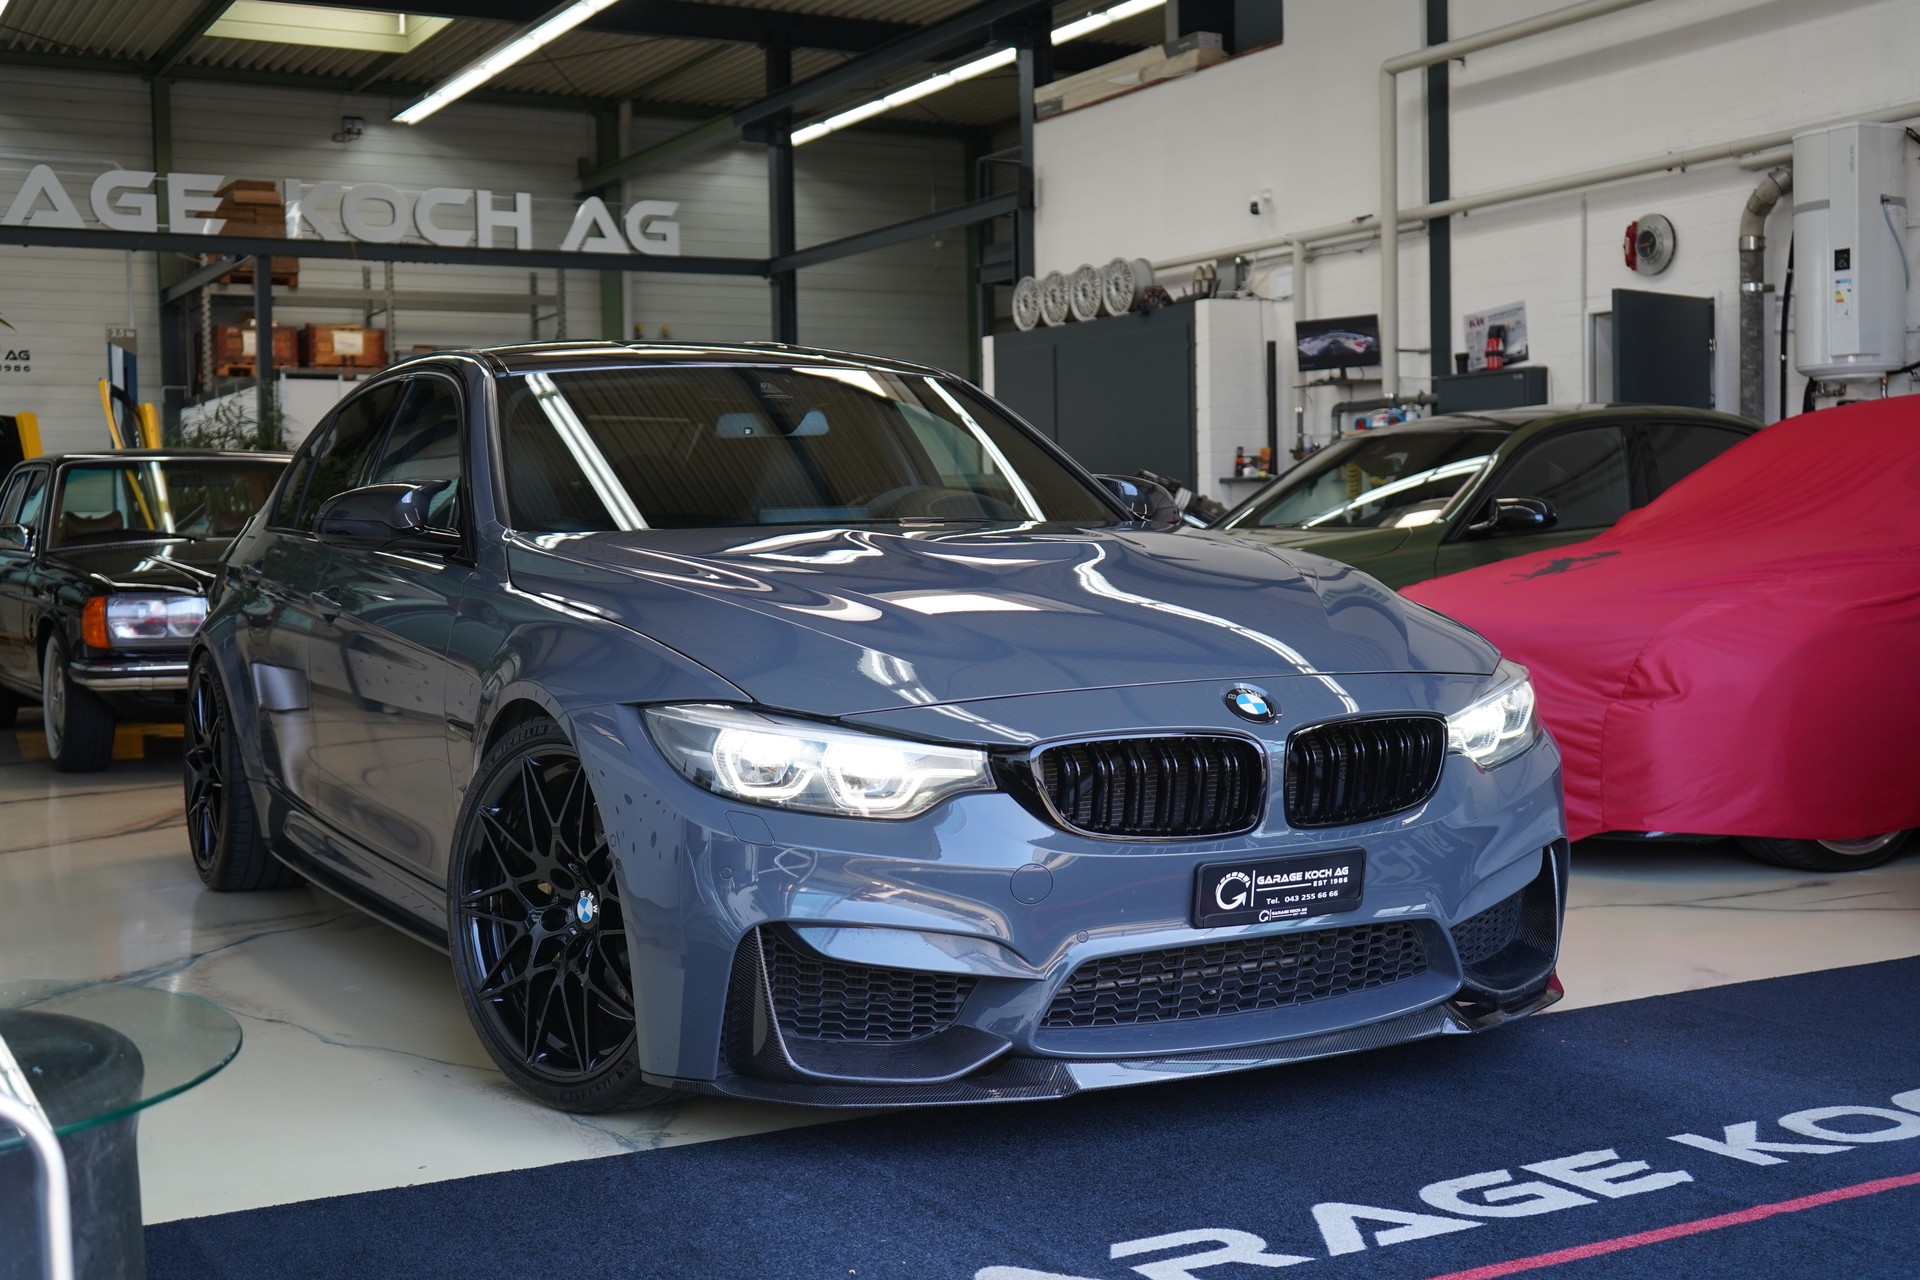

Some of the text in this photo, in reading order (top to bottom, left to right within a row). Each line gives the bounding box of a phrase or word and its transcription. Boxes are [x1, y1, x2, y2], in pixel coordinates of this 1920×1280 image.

[1, 164, 681, 256] AGE KOCH AG
[4, 349, 31, 361] AG
[494, 725, 548, 760] MICHELIN
[1256, 866, 1350, 885] GARAGE KOCH AG
[1312, 876, 1349, 887] EST 1986
[579, 889, 599, 914] BMW
[1266, 890, 1339, 905] Tel. 043 255 66 66
